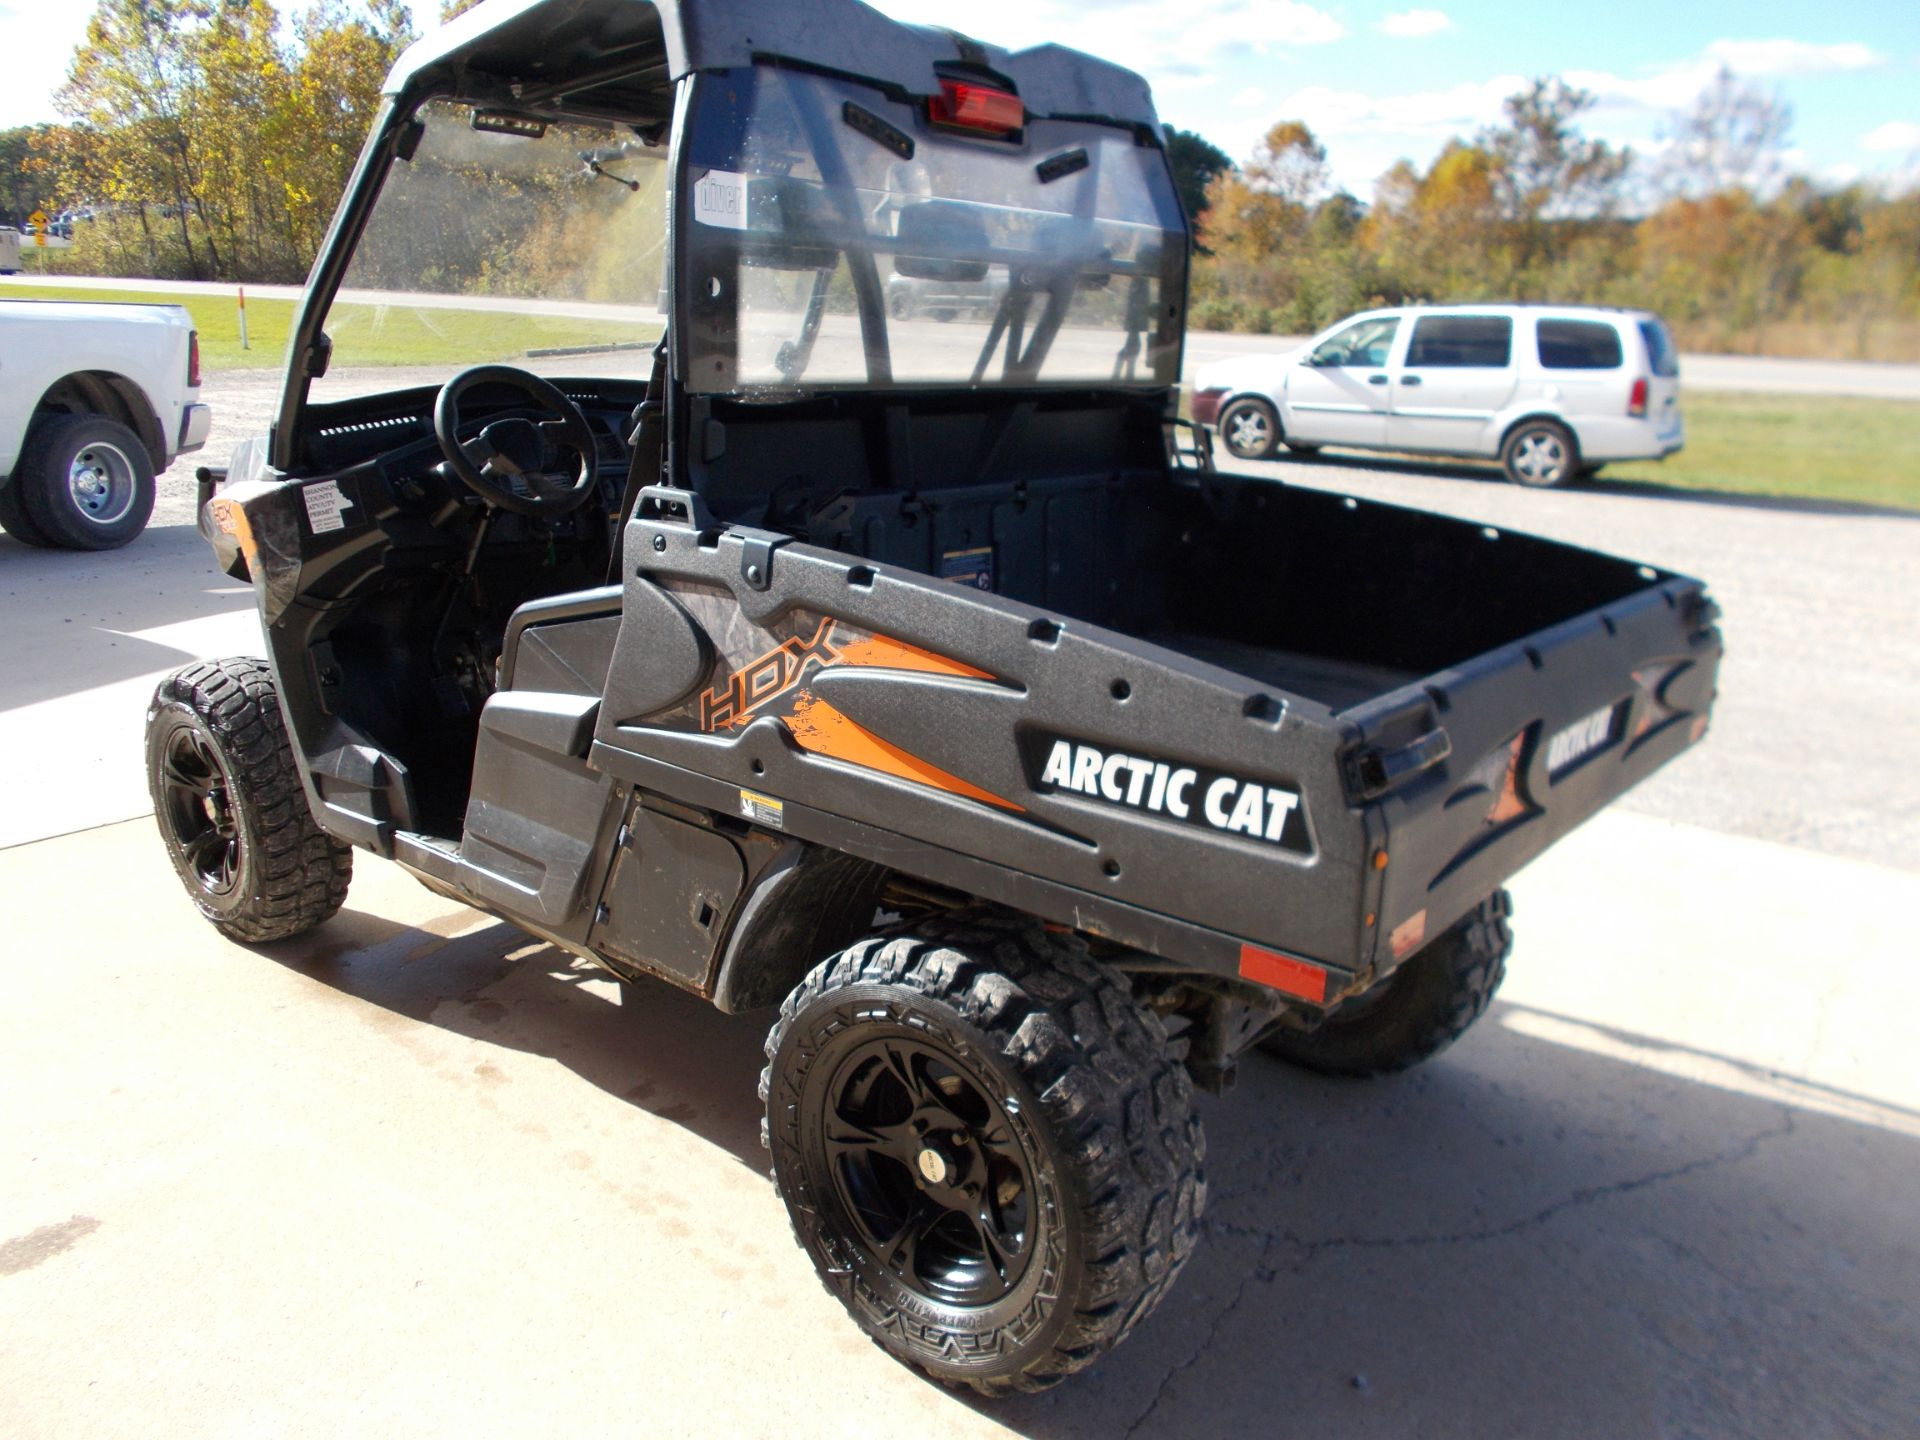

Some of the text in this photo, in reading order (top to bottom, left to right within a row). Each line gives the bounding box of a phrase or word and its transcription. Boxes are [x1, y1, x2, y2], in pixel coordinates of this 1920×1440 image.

[306, 492, 333, 504] COUNTY
[309, 507, 334, 518] PERMIT
[700, 616, 844, 732] HDX
[1041, 740, 1299, 842] ARCTIC CAT
